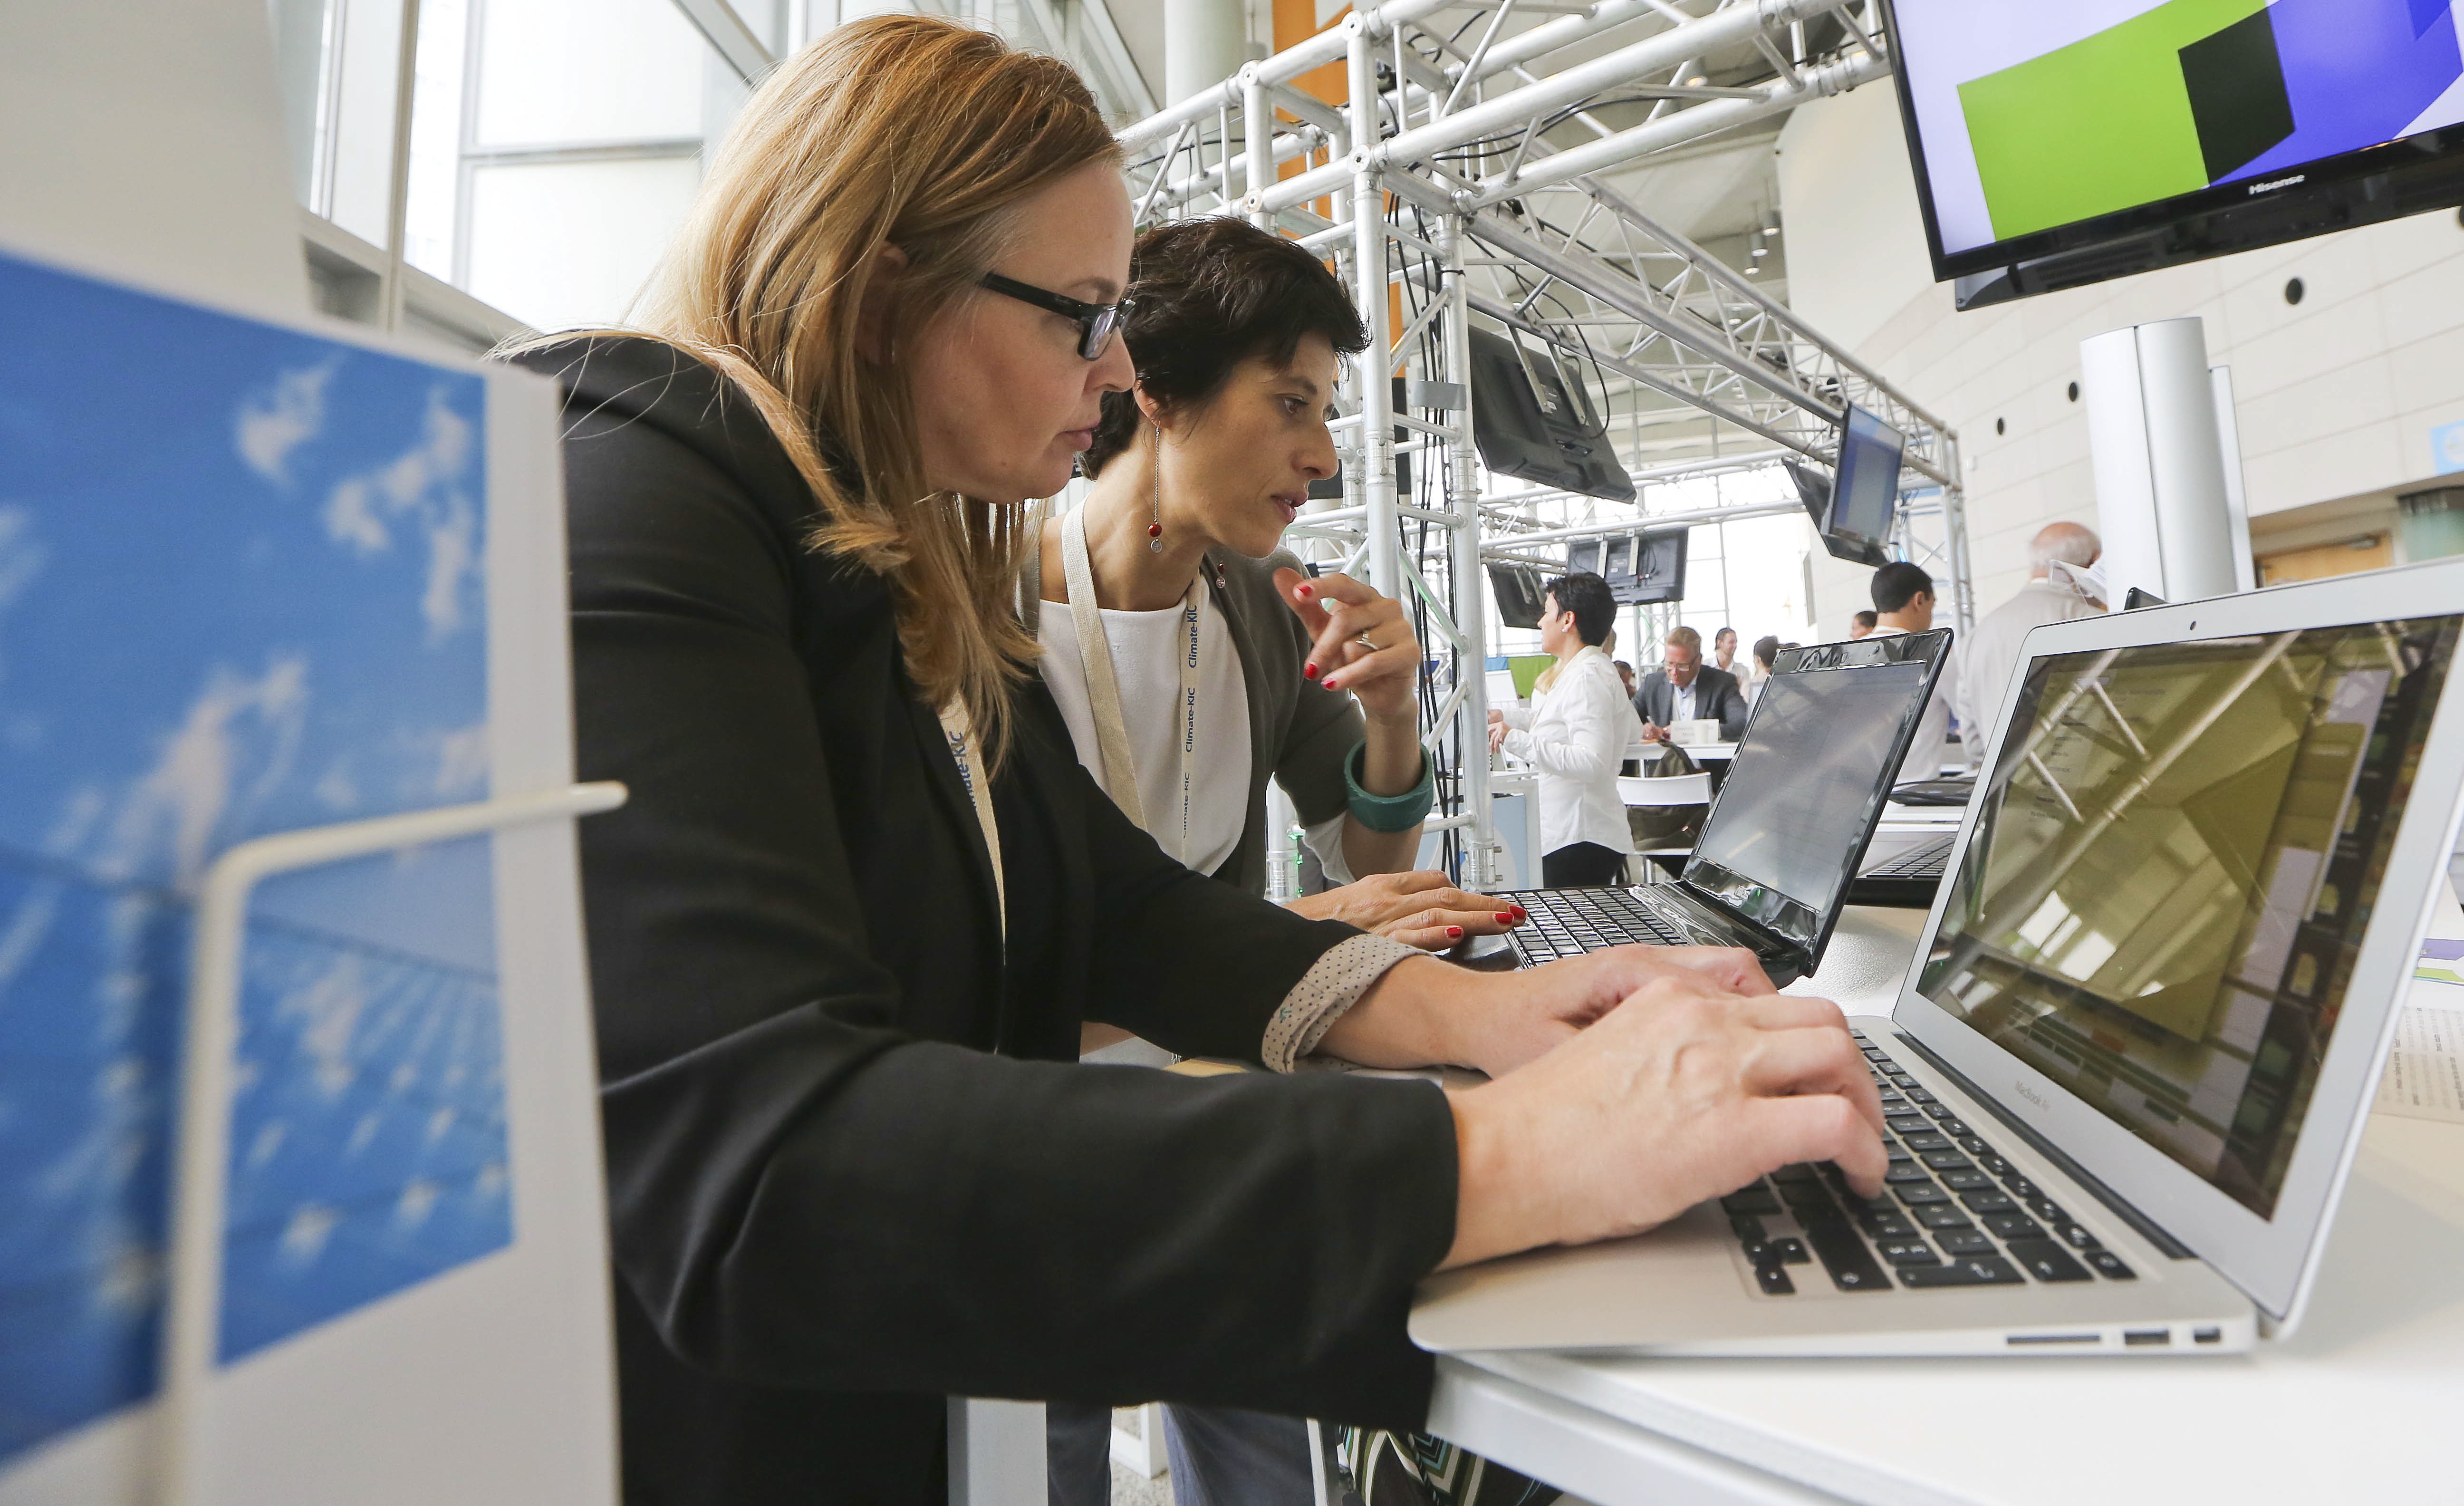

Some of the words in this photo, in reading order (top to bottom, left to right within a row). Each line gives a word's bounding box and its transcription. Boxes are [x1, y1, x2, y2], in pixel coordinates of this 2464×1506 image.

[2249, 174, 2305, 195] Hisense
[1186, 605, 1198, 668] Climate-KIC
[1185, 687, 1195, 753] Climate-KIC
